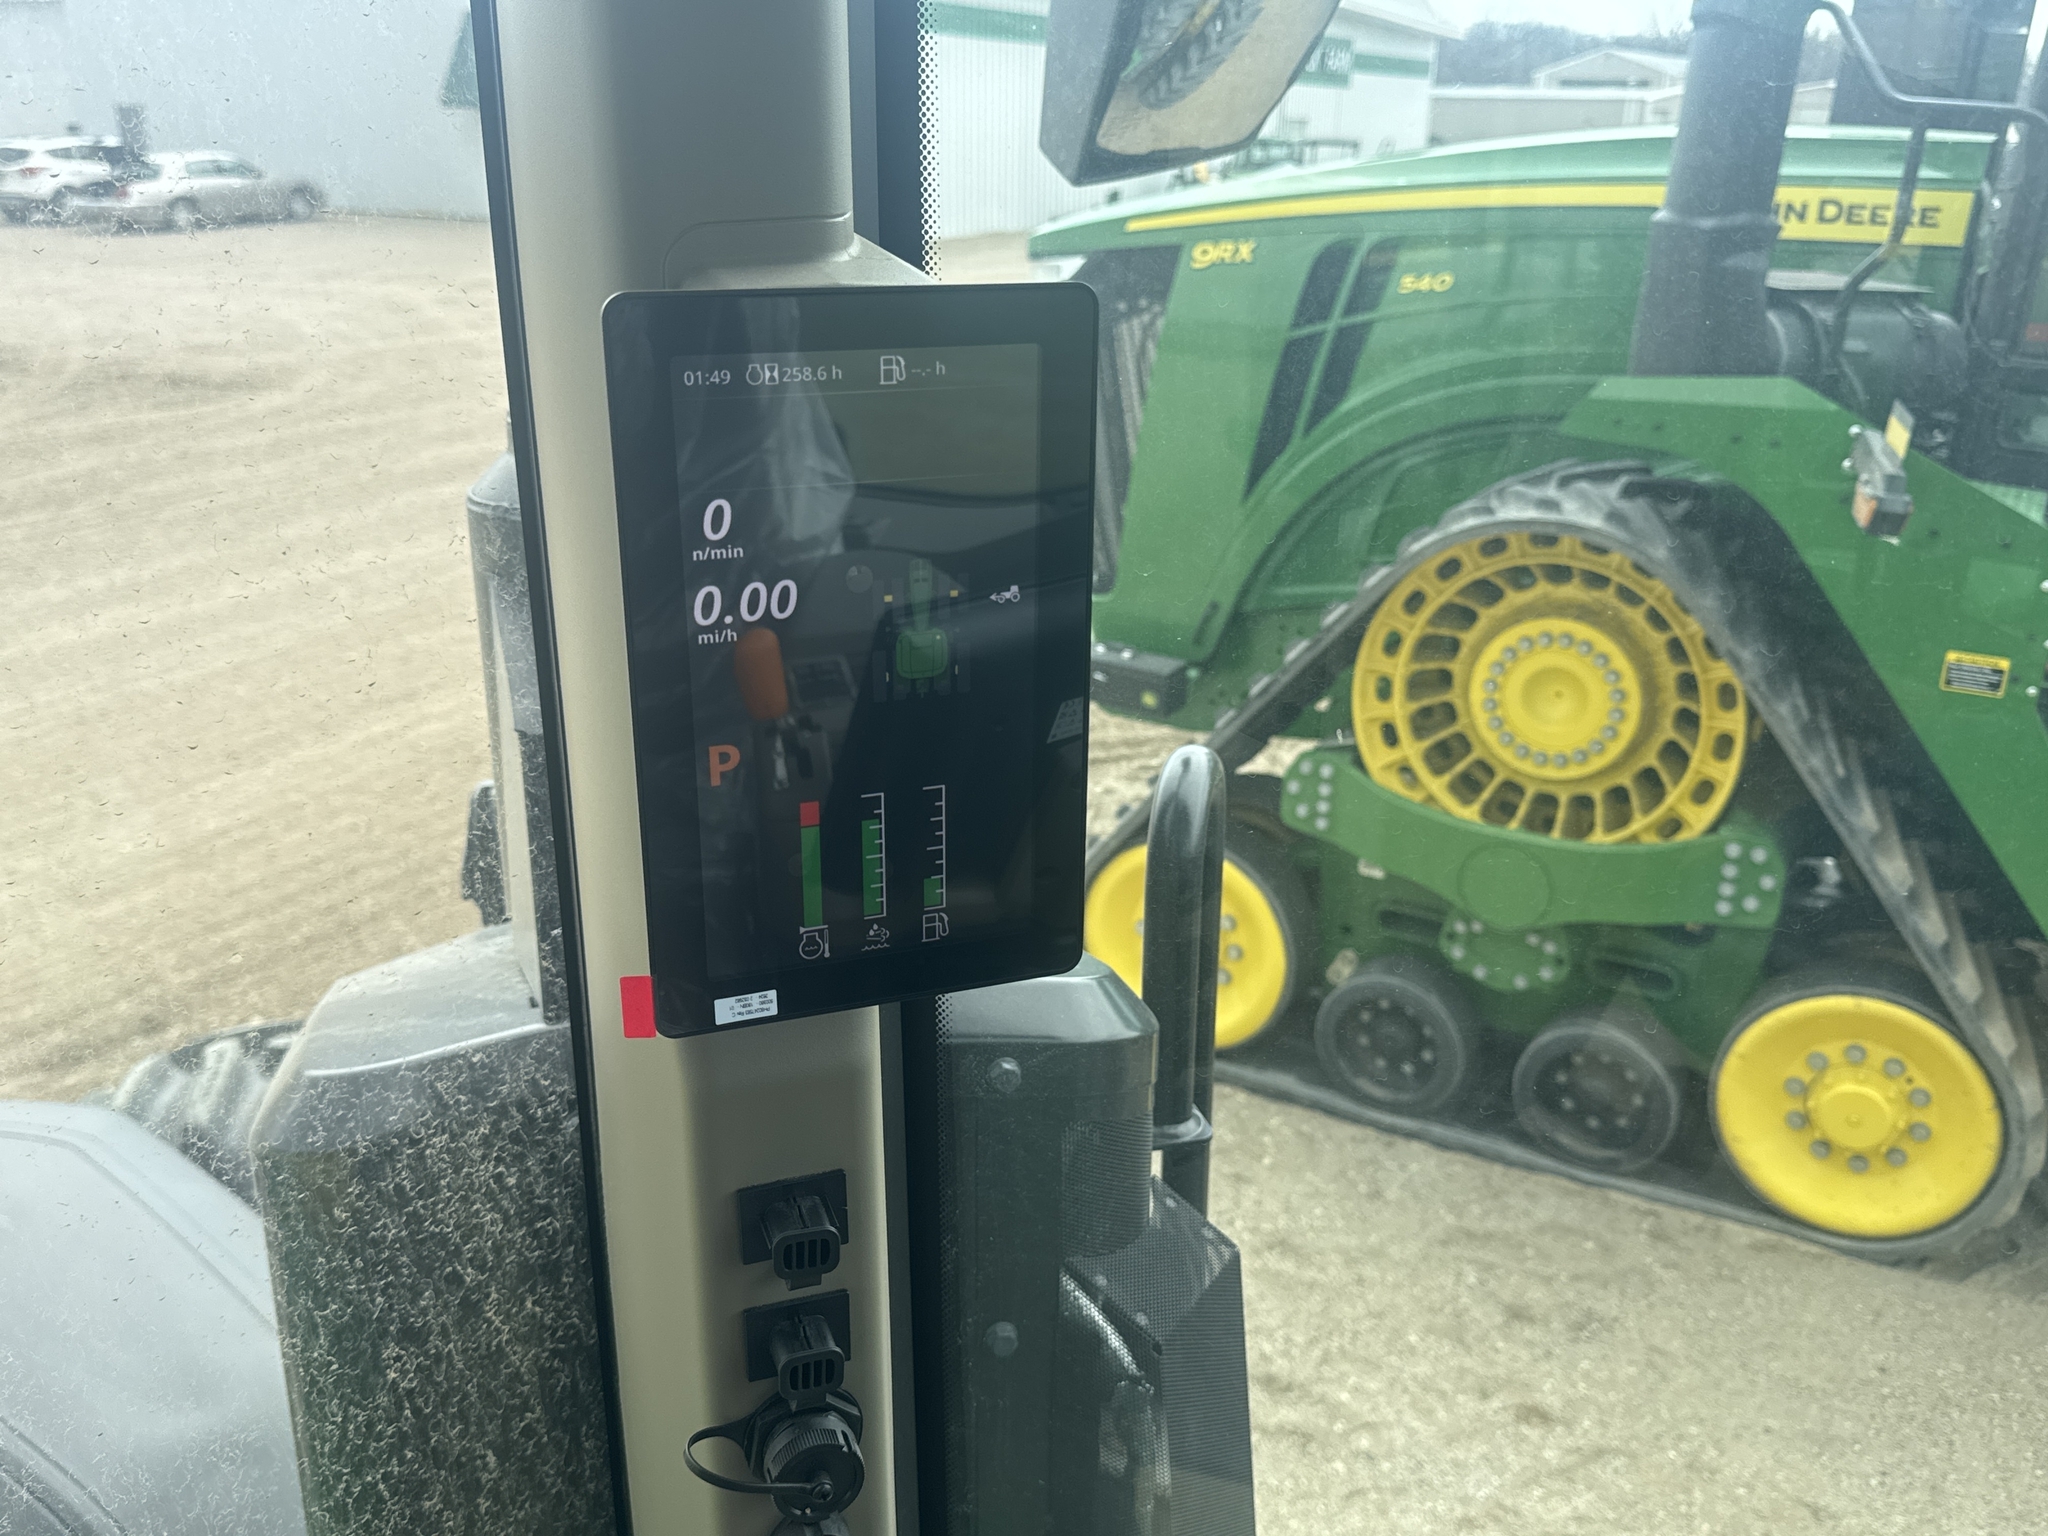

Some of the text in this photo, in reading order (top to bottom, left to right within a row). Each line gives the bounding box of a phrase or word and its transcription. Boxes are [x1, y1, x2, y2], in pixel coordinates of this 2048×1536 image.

[1817, 198, 1941, 229] DEEE
[1190, 240, 1257, 270] 9RX
[1397, 270, 1455, 295] 540
[683, 369, 731, 387] 01:49
[782, 364, 843, 383] 258.6 h
[702, 498, 732, 542] 0
[692, 544, 745, 562] n/min
[693, 579, 798, 627] 0.00
[698, 628, 738, 645] mi/h
[708, 744, 741, 787] P
